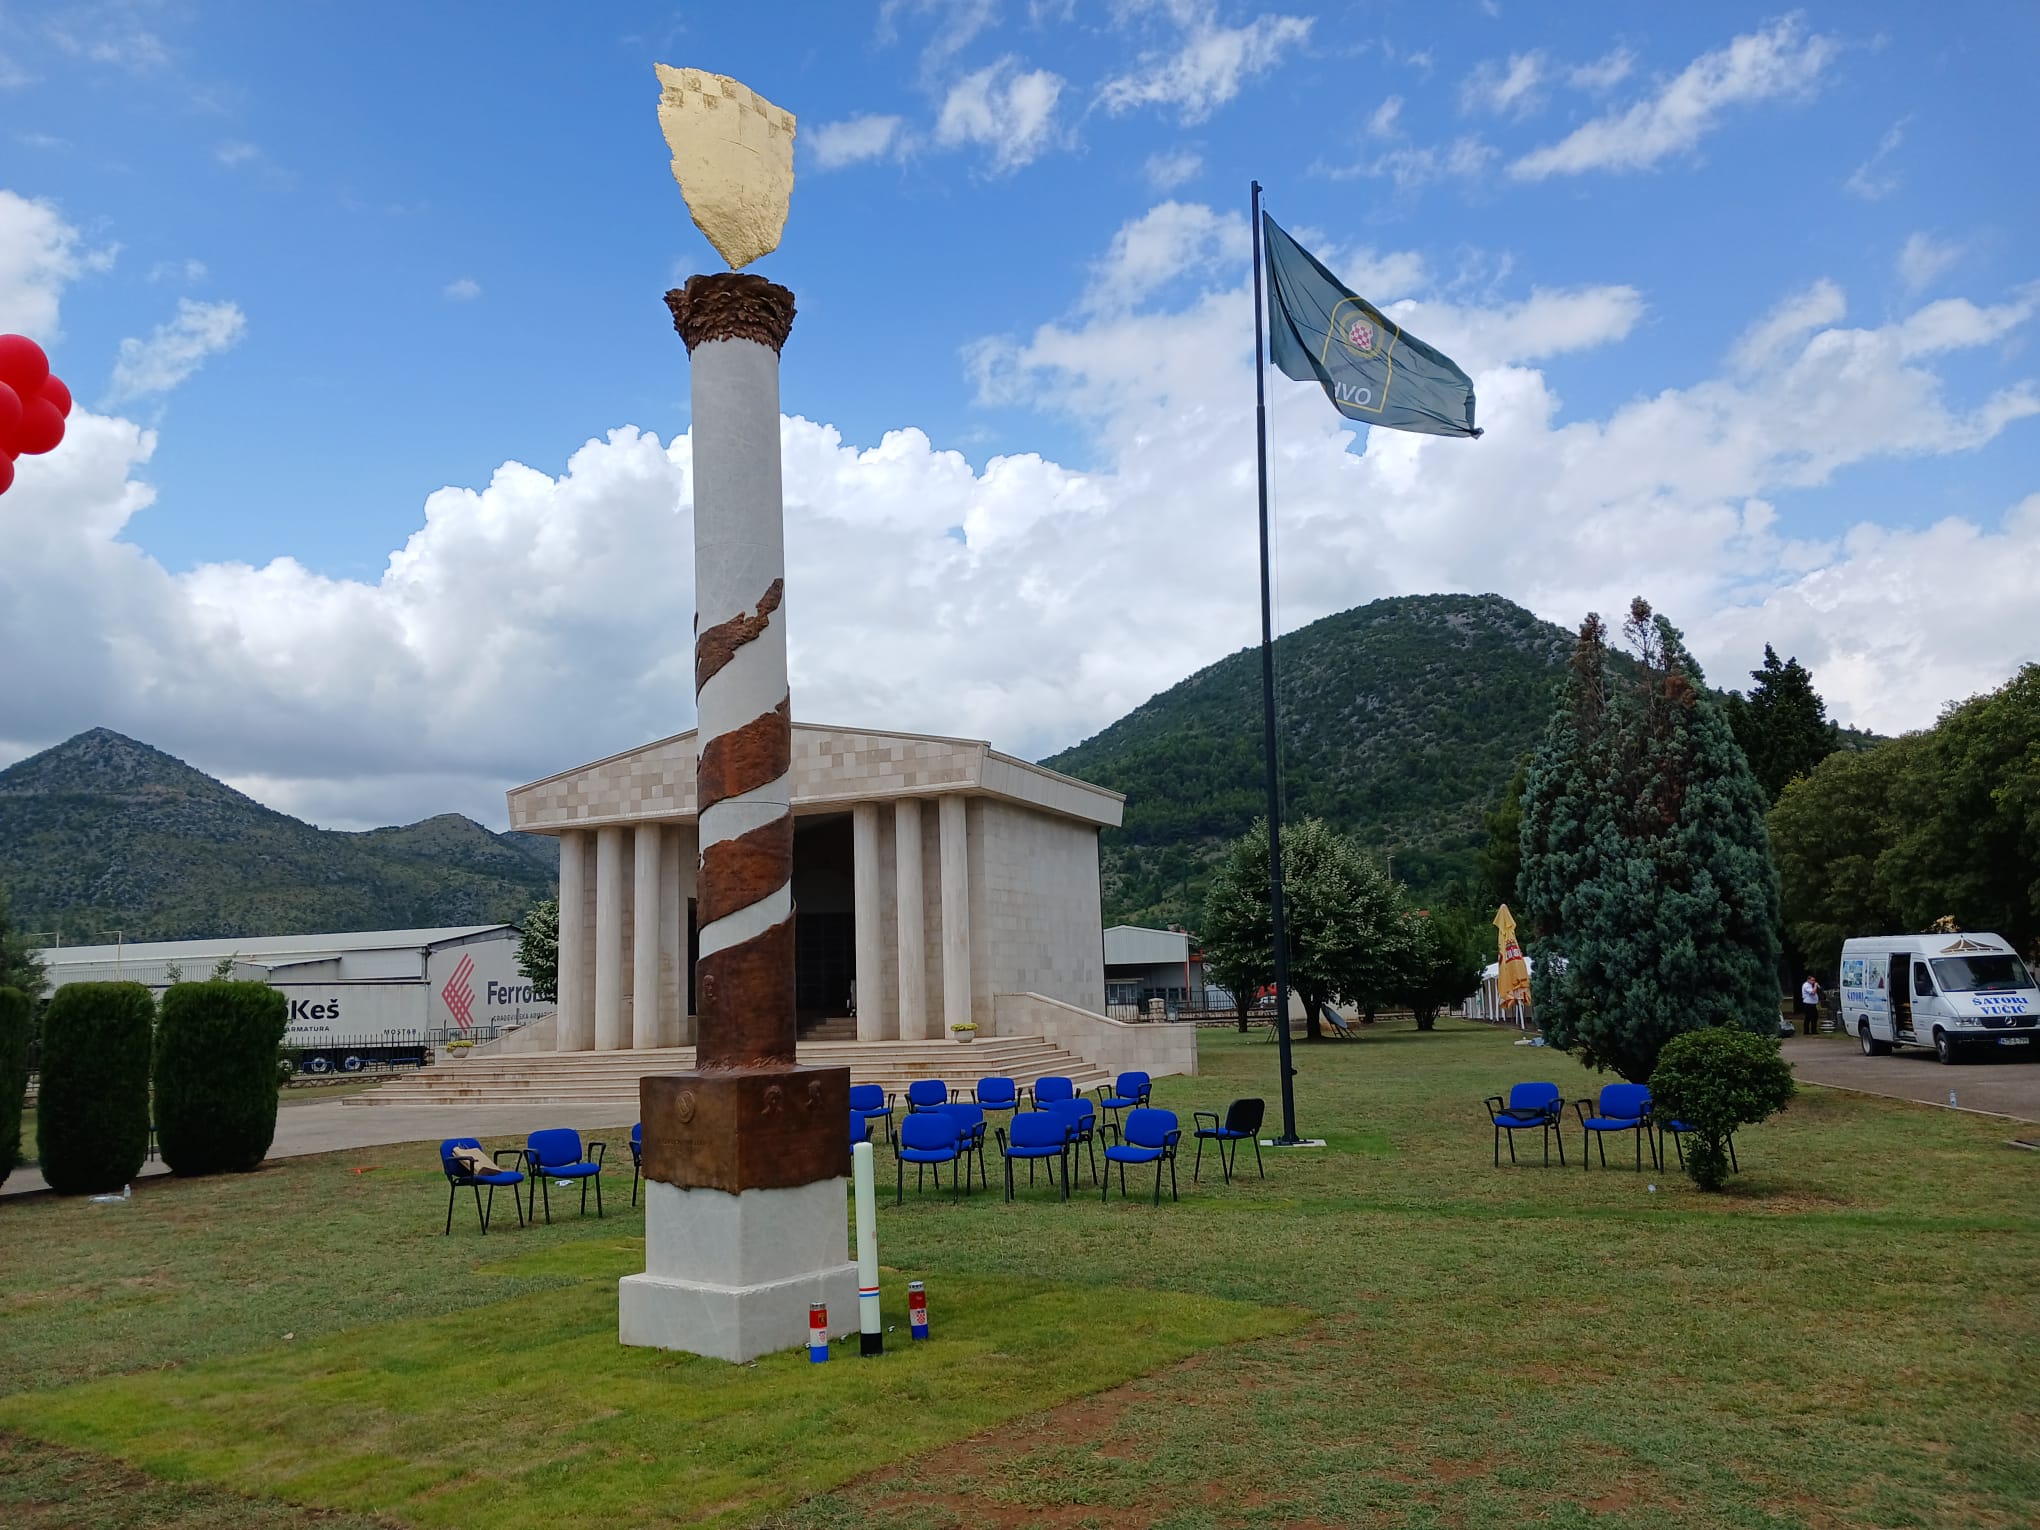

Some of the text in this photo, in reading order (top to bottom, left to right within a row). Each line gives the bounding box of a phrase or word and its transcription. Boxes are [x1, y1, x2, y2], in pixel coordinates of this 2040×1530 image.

[487, 981, 550, 1005] Ferro
[1972, 996, 2028, 1005] ŠATORI
[286, 998, 340, 1020] Keš
[1981, 1004, 2027, 1014] VUČIĆ
